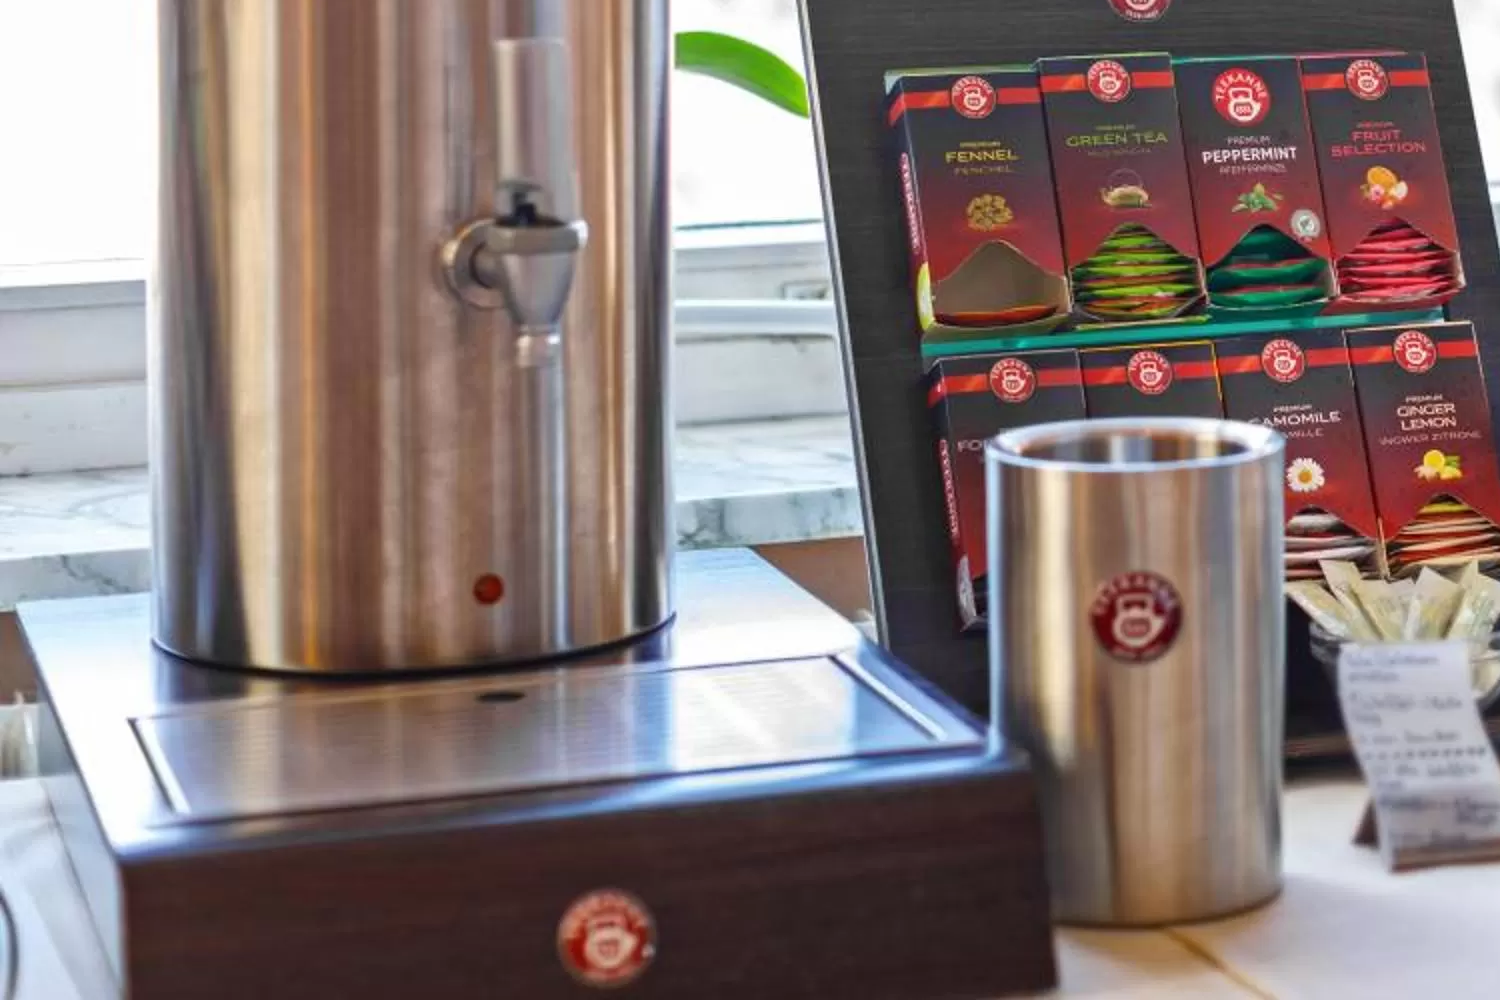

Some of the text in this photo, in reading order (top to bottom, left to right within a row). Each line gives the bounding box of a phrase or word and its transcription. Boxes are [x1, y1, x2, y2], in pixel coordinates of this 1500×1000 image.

[1216, 72, 1267, 101] TEEKANNE
[1065, 131, 1168, 147] GREEN TEA
[1352, 129, 1401, 142] FRUIT
[1202, 146, 1297, 164] PEPPERMINT
[1331, 140, 1426, 156] SELECTION
[945, 149, 1021, 164] FENNEL
[1397, 403, 1456, 417] GINGER
[1401, 416, 1456, 431] LEMON
